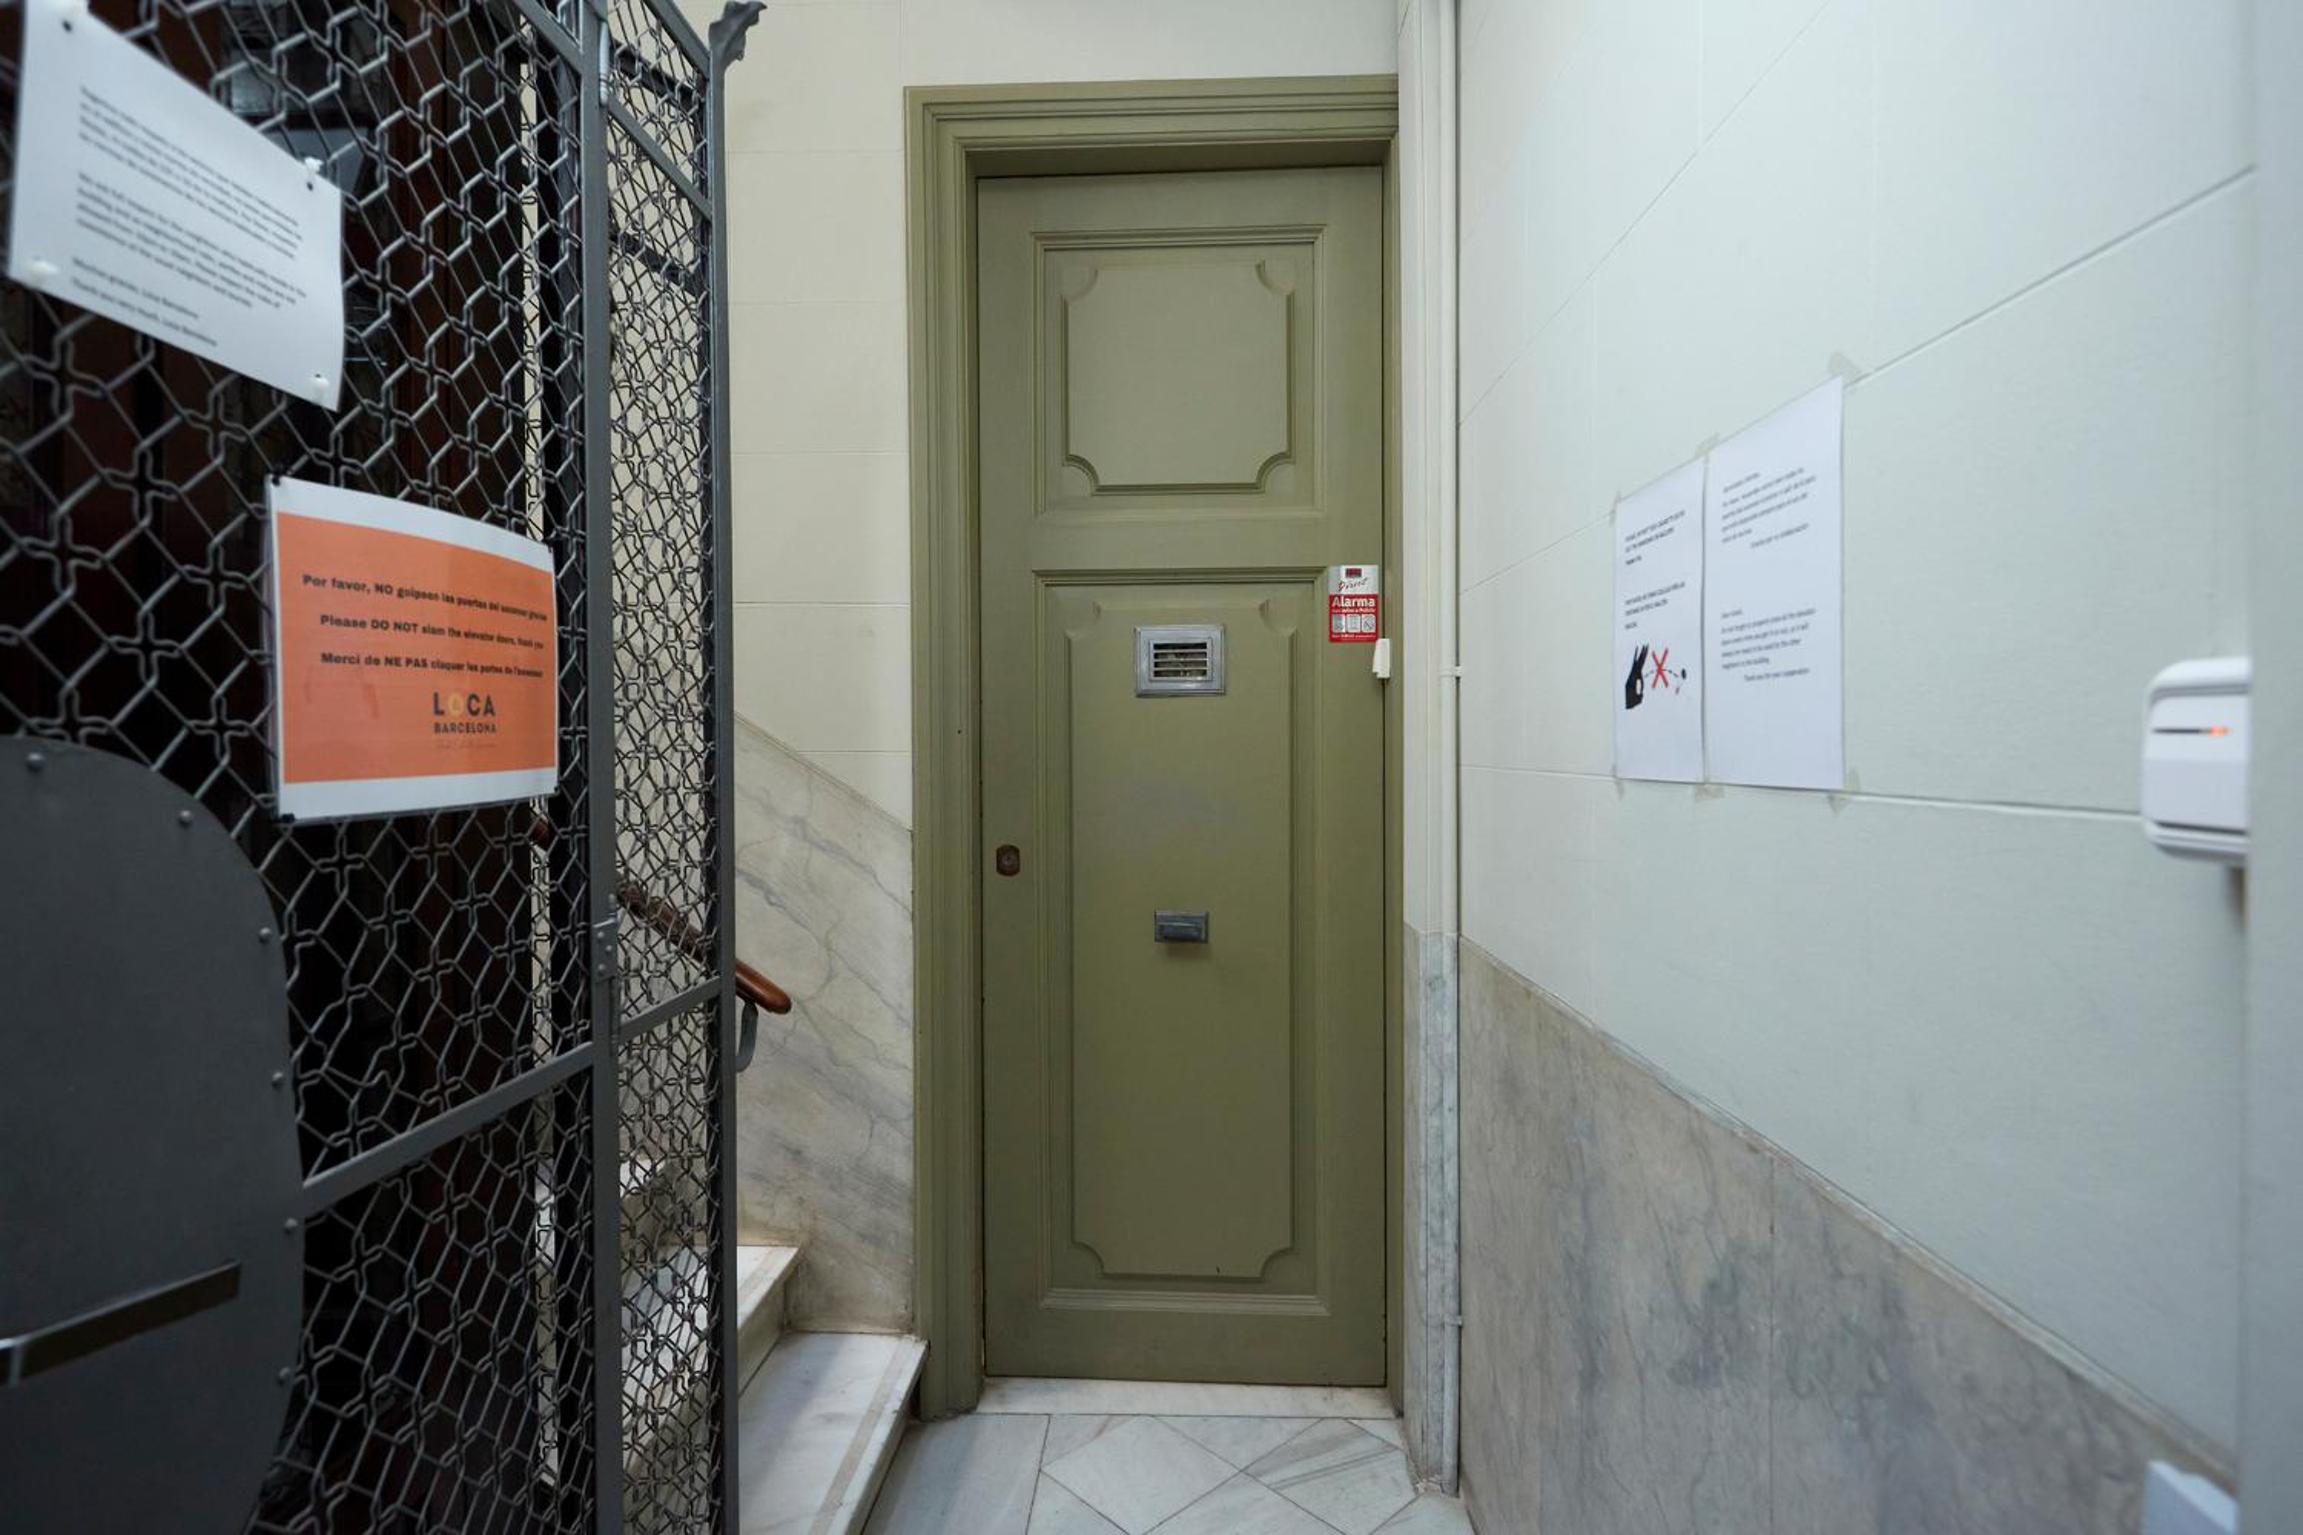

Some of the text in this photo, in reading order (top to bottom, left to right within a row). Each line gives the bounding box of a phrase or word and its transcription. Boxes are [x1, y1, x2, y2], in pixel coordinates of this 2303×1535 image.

[302, 573, 327, 587] Por
[331, 577, 371, 595] favor,
[374, 583, 394, 595] NO
[1333, 596, 1375, 607] Alarma
[320, 614, 368, 629] Please
[371, 619, 391, 631] DO
[393, 622, 418, 633] NOT
[421, 624, 446, 635] slam
[447, 627, 461, 638] the
[320, 652, 360, 665] Merci
[364, 655, 382, 666] de
[383, 656, 403, 667] NE
[405, 658, 428, 669] PAS
[433, 721, 497, 734] BARCELONA
